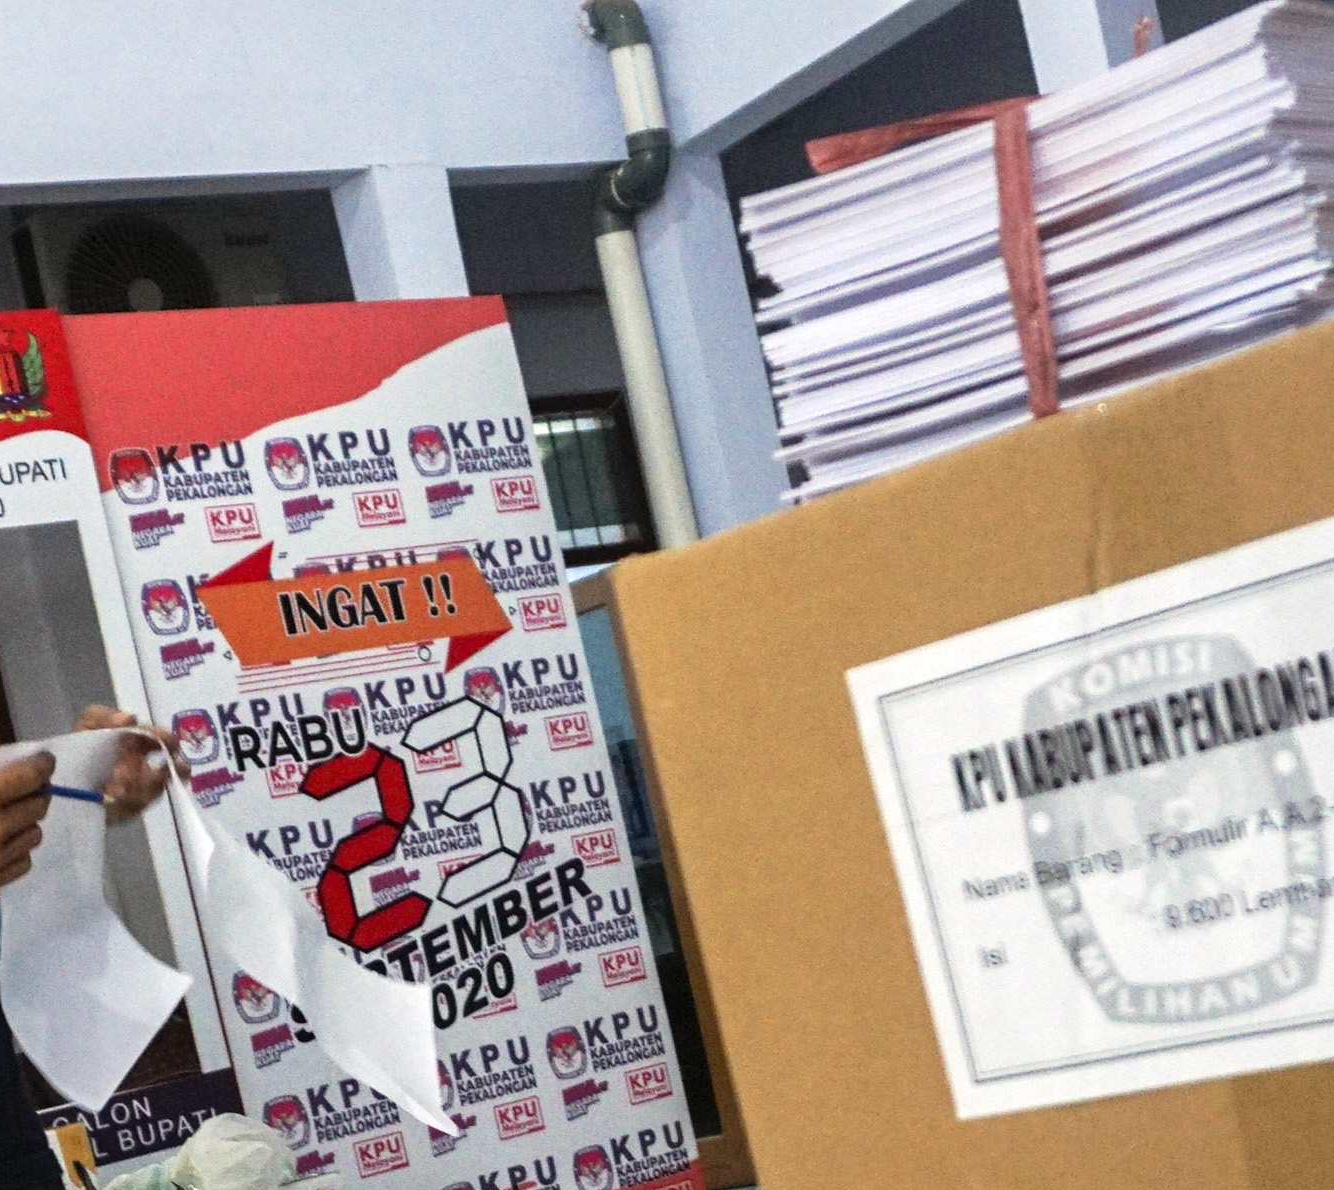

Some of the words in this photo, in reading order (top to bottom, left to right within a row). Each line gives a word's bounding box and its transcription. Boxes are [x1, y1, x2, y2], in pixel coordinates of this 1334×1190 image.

[306, 427, 392, 462] KPU
[447, 416, 526, 450] KPU
[155, 439, 247, 475] KPU
[313, 456, 396, 476] KABUPATEN
[454, 444, 530, 463] KABUPATEN
[456, 455, 534, 476] PEKALONGAN
[162, 469, 251, 493] KABUPATEN
[166, 481, 255, 503] PEKALONGAN
[315, 468, 399, 489] PEKALONGAN
[494, 479, 534, 500] KPU
[356, 492, 400, 512] KPU
[209, 507, 254, 527] KPU
[475, 534, 552, 569] KPU
[277, 579, 407, 637] INGAT
[422, 572, 458, 618] !!
[520, 598, 561, 619] KPU
[502, 653, 580, 689] KPU
[1048, 639, 1213, 712] KOMISI
[363, 672, 447, 711] KPU
[508, 681, 584, 702] KABUPATEN
[511, 693, 586, 715] PEKALONGAN
[216, 692, 305, 733] KPU
[548, 715, 587, 736] KPU
[228, 708, 368, 772] RABU
[949, 742, 1007, 815] KPU
[1003, 698, 1170, 800] KABUPATEN
[529, 770, 607, 810] KPU
[535, 801, 611, 823] KABUPATEN
[537, 812, 614, 835] PEKALONGAN
[399, 821, 480, 847] KABUPATEN
[402, 835, 483, 861] PEKALONGAN
[574, 833, 613, 853] KPU
[559, 886, 633, 928] KPU
[562, 914, 637, 941] KABUPATEN
[565, 927, 640, 954] PEKALONGAN
[601, 950, 641, 972] KPU
[583, 1003, 659, 1047] KPU
[450, 1035, 531, 1082] KPU
[589, 1031, 663, 1059] KABUPATEN
[591, 1043, 666, 1074] PEKALONGAN
[456, 1063, 535, 1092] KABUPATEN
[459, 1076, 538, 1106] PEKALONGAN
[628, 1066, 667, 1089] KPU
[306, 1077, 388, 1117] KP
[312, 1100, 398, 1129] KABUPATEN
[496, 1100, 538, 1124] KPU
[316, 1112, 402, 1144] PEKALONGAN
[357, 1138, 402, 1164] KPU
[609, 1119, 686, 1166] KPU
[615, 1147, 690, 1175] KABUPATEN
[618, 1159, 693, 1189] PEKALONGAN
